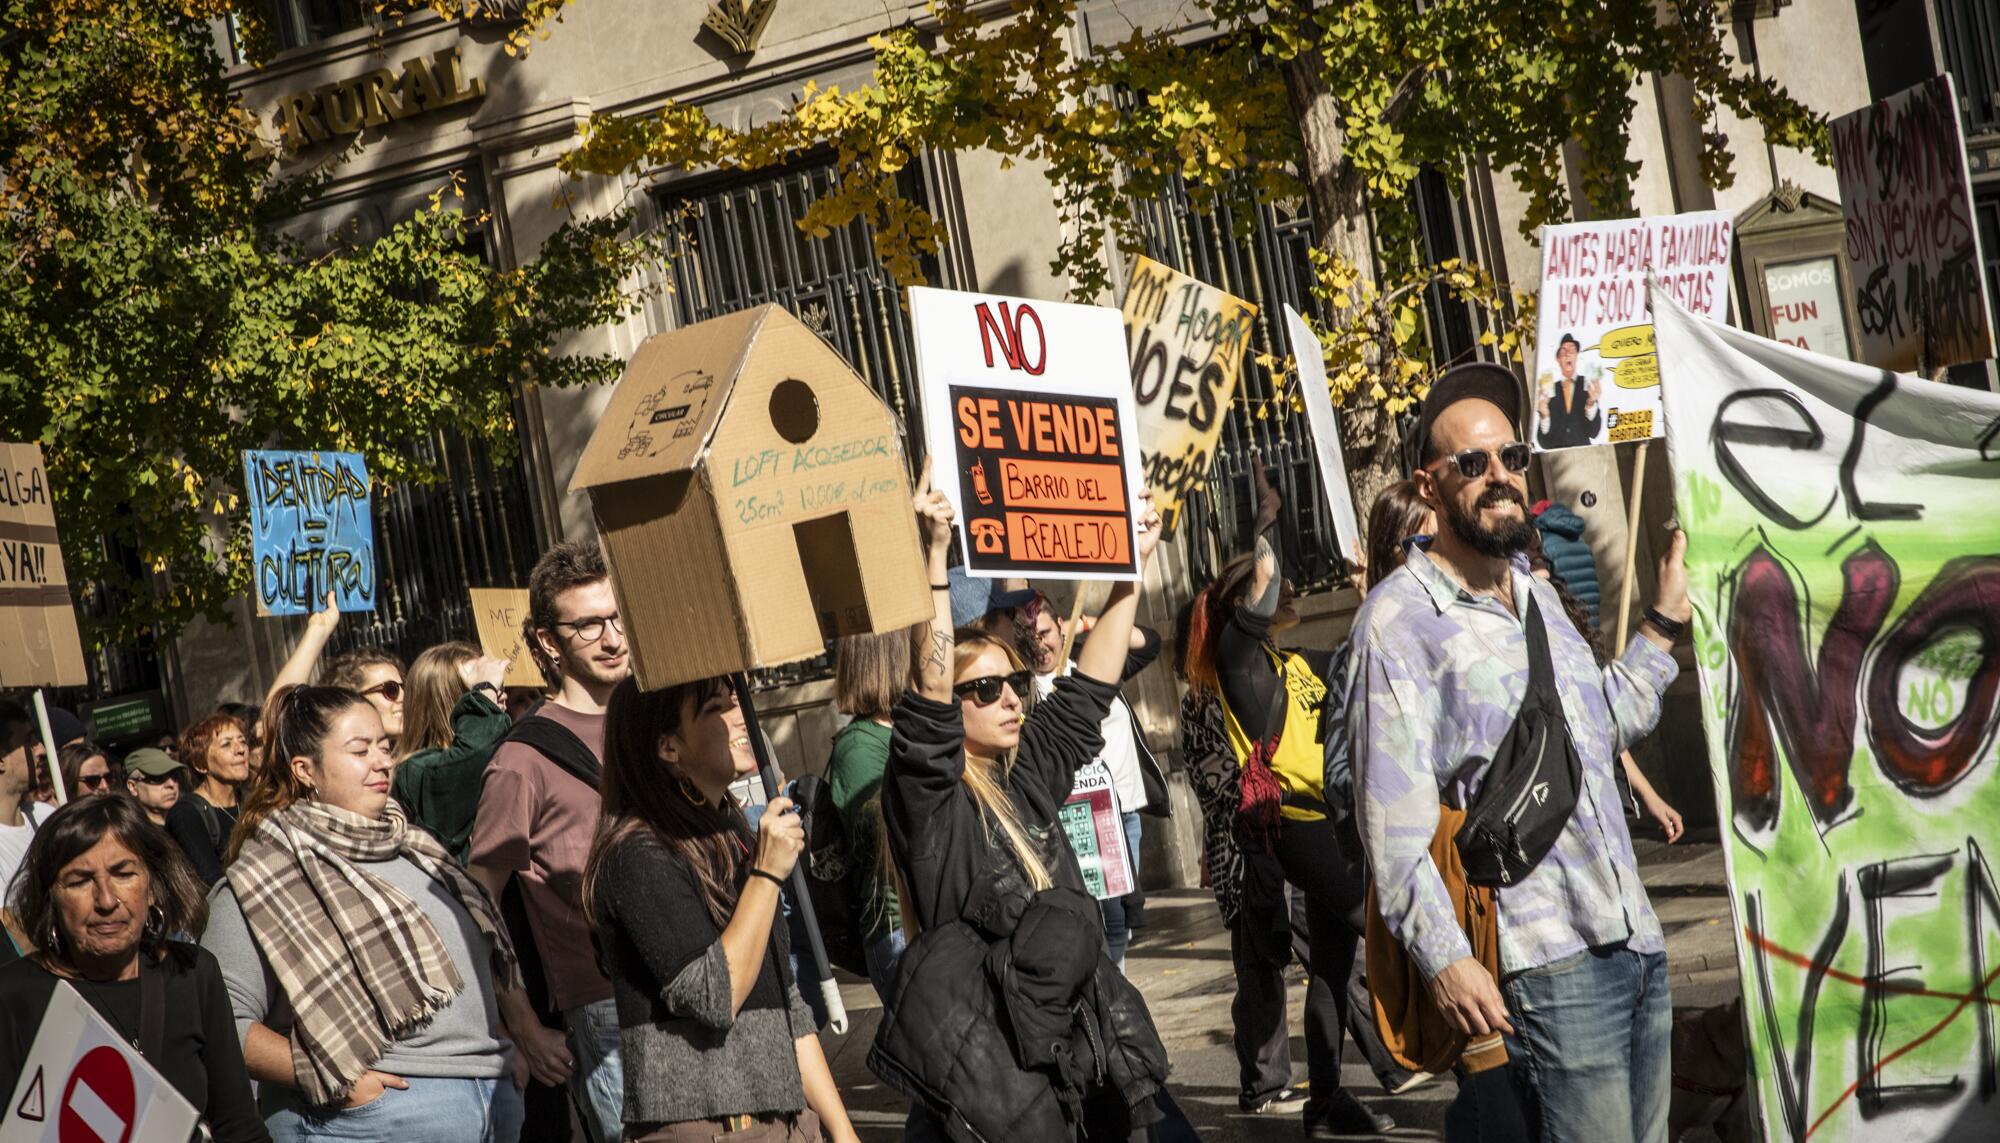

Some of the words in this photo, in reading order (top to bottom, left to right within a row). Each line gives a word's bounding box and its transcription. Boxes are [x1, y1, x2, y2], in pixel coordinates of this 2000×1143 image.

[273, 48, 485, 147] RURAL
[1547, 232, 1600, 280] ANTES
[1605, 221, 1654, 273] HABÍA
[1659, 220, 1730, 270] FAMILIAS
[1558, 284, 1592, 328] HOY
[1596, 275, 1635, 325] SÓLO
[1642, 270, 1714, 320] TRISTAS
[1767, 268, 1832, 292] SOMOS
[975, 301, 1046, 376] NO
[1771, 300, 1818, 325] FUN
[1165, 355, 1224, 433] ES
[957, 396, 1004, 449] SE
[1008, 400, 1119, 457] VENDE
[732, 449, 785, 487] LOFT
[793, 435, 890, 473] ACOGEDOR
[1077, 478, 1107, 500] DEL
[1022, 515, 1117, 560] REALEJO
[1717, 524, 2000, 858] NO
[1906, 672, 1953, 726] NO
